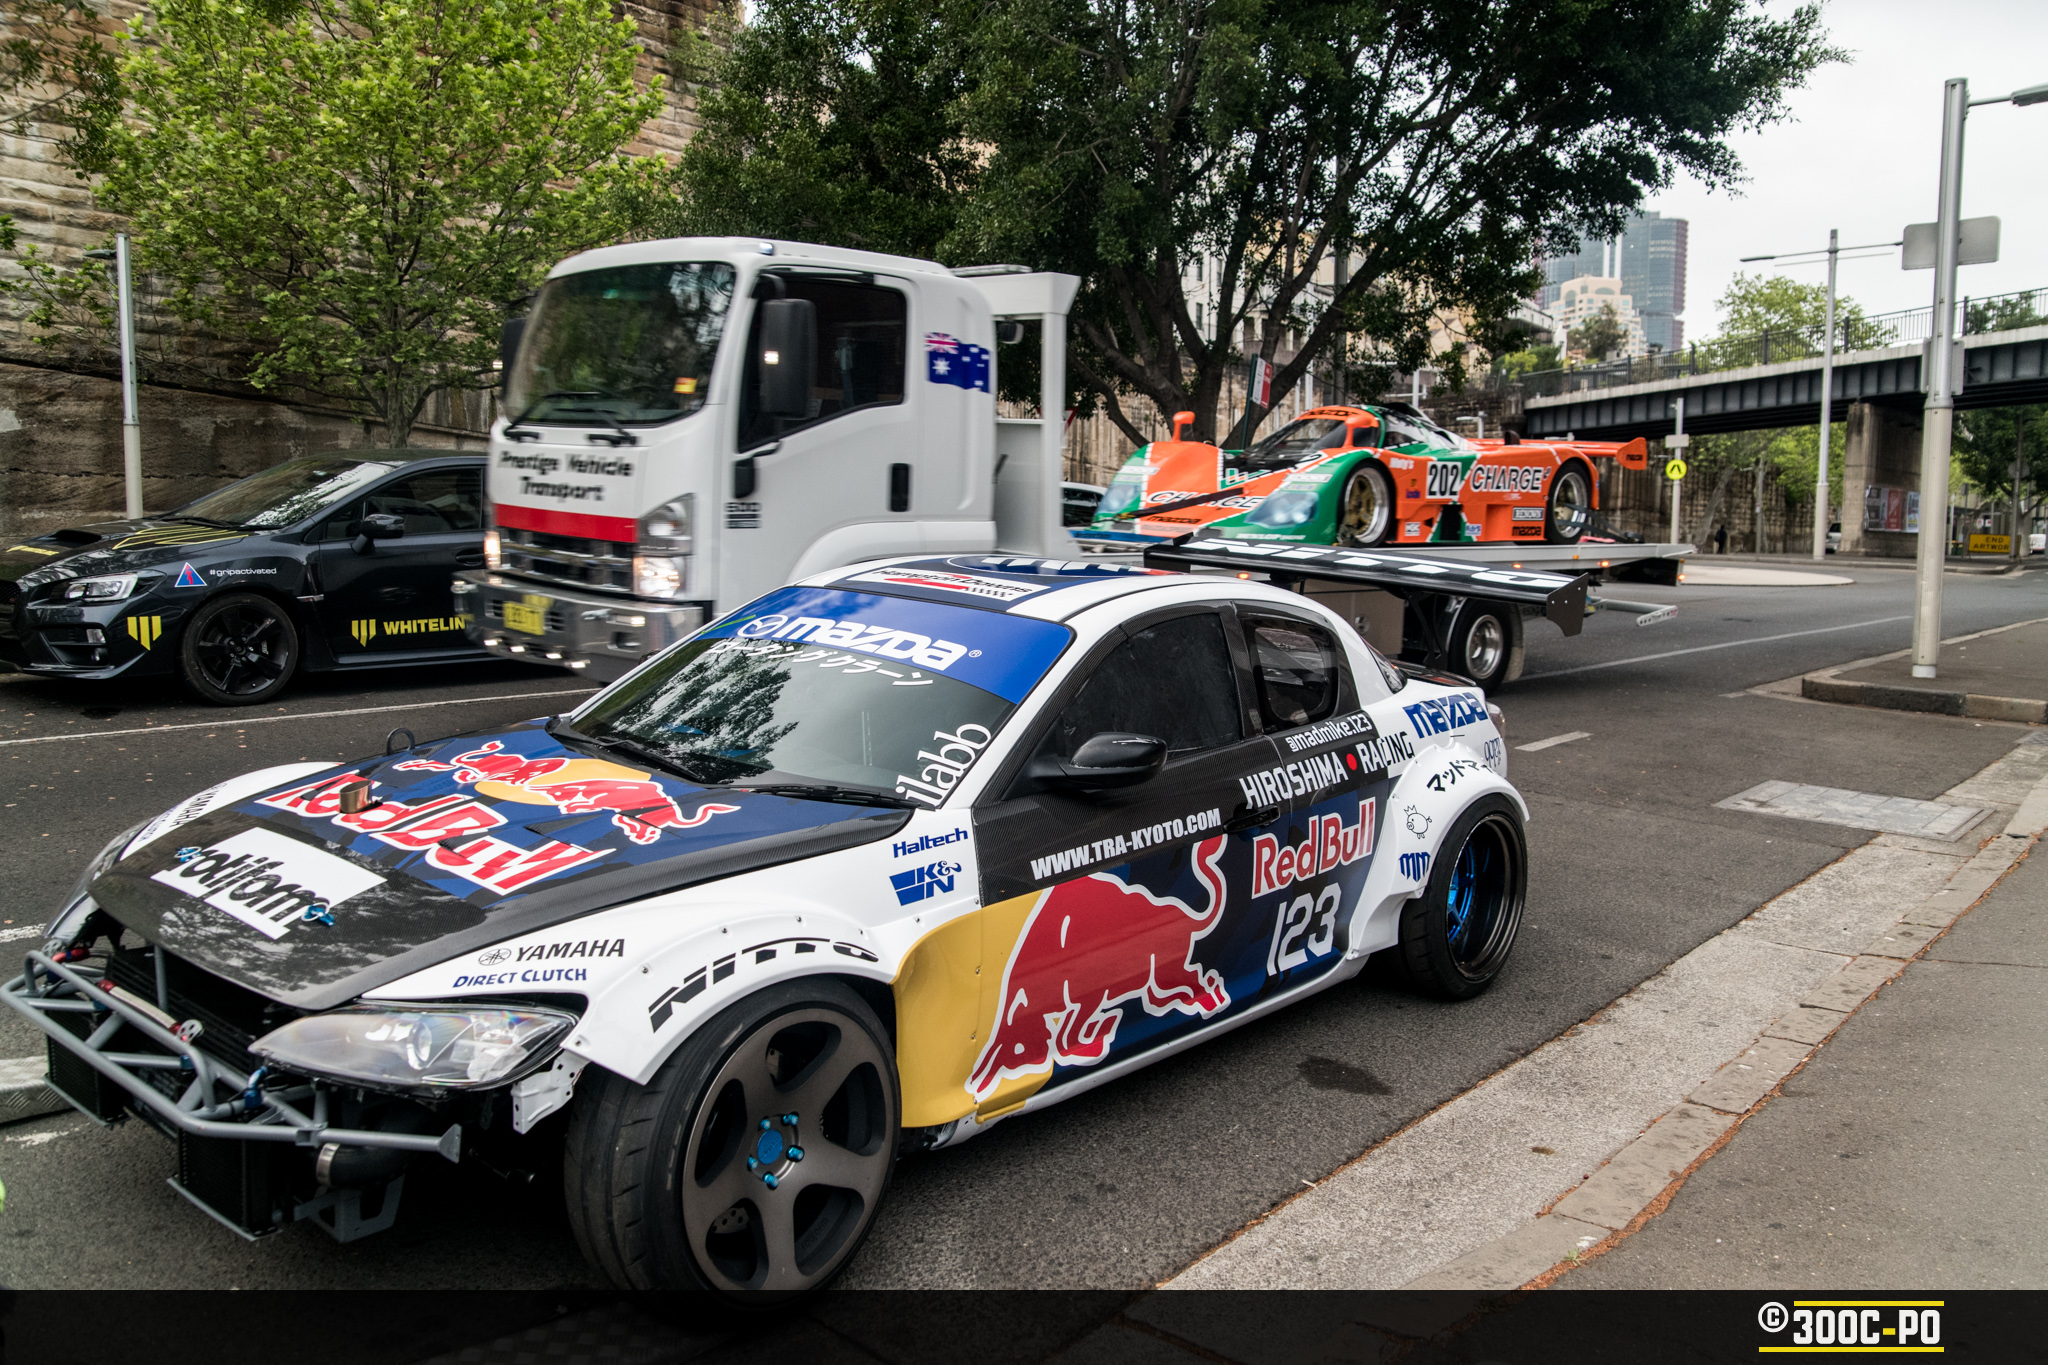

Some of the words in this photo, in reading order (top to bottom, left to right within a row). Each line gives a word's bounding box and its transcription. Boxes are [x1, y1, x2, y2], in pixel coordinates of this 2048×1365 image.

[1428, 463, 1460, 497] 202
[1472, 464, 1543, 493] CHARGE
[1147, 490, 1267, 510] CHGE
[1985, 536, 2005, 544] END
[209, 567, 277, 577] #gripactivated
[961, 577, 1032, 594] Downs
[383, 616, 470, 636] WHITELIN
[1286, 713, 1373, 753] @madmike.123
[895, 722, 992, 807] ilabb
[1239, 751, 1349, 810] HIROSHIMA
[1355, 731, 1416, 774] RACING
[892, 828, 969, 859] Haltech
[1030, 807, 1222, 881] WWW.TRA-KYOTO.COM
[1267, 881, 1342, 977] 123
[514, 938, 625, 963] YAMAHA
[452, 970, 519, 989] DIRECT
[520, 967, 588, 983] CLUTCH
